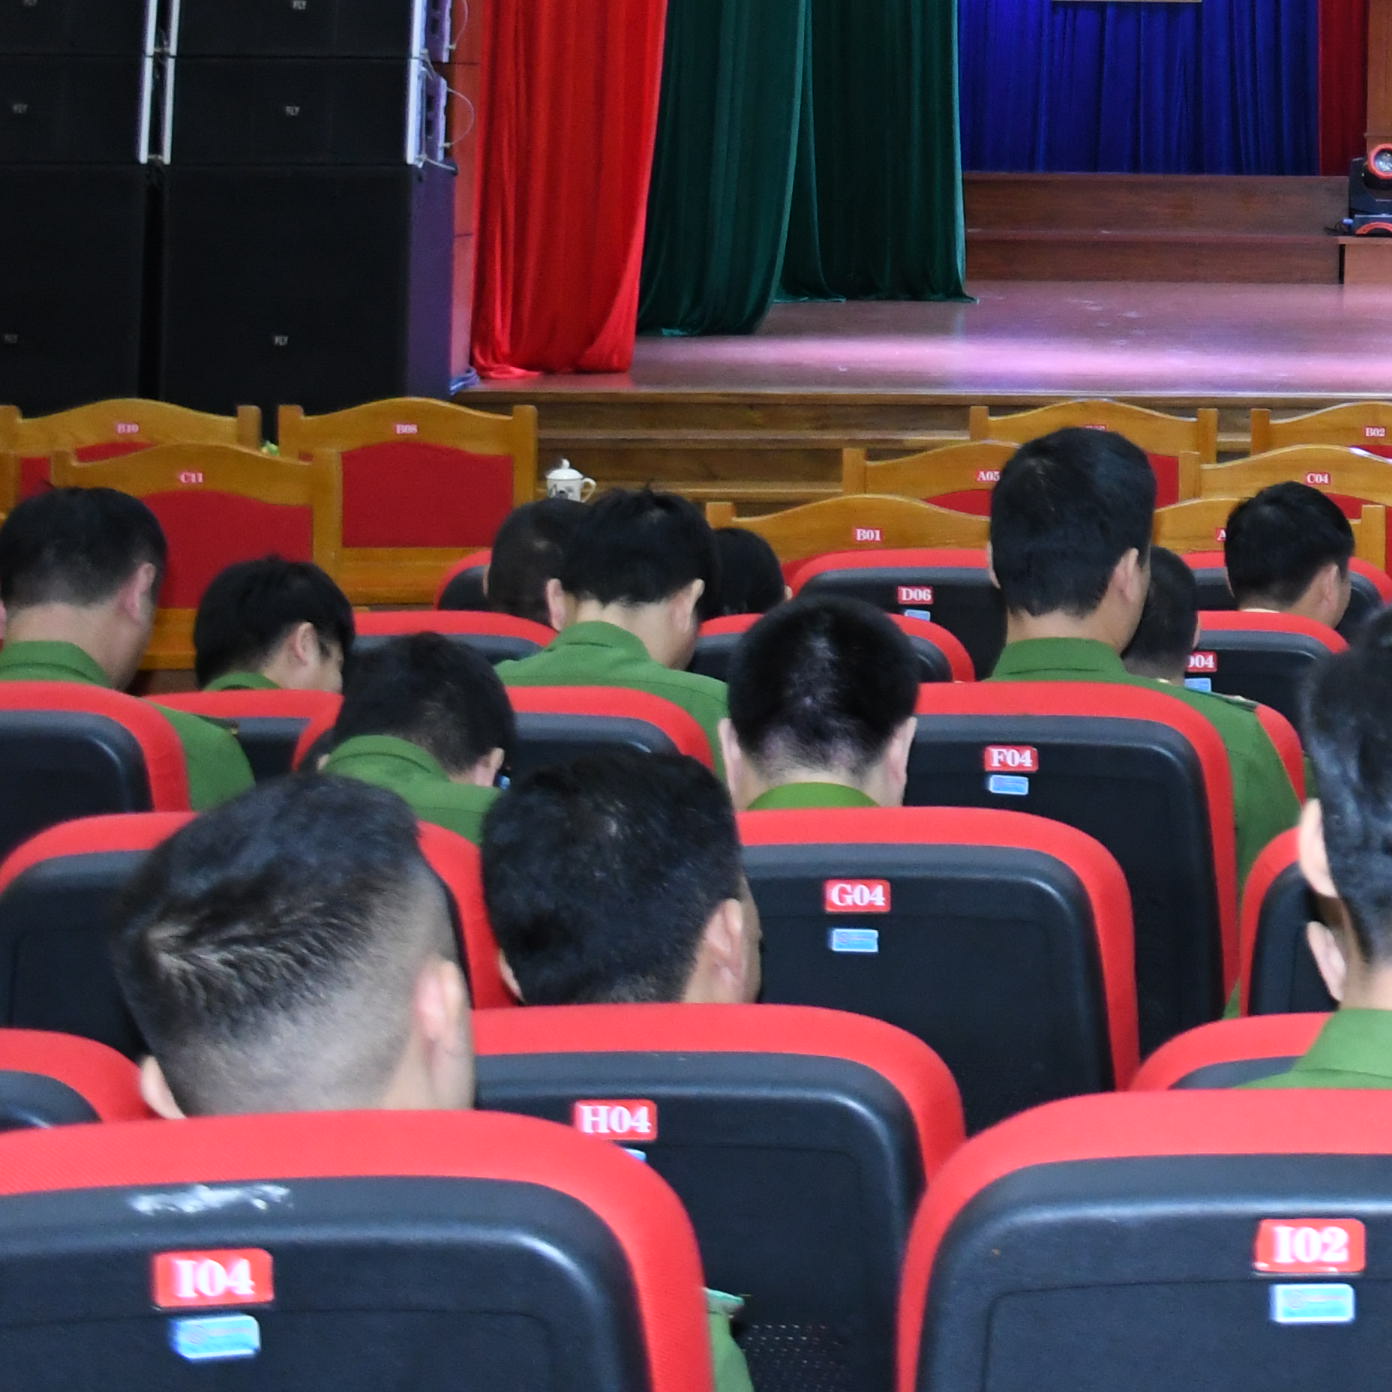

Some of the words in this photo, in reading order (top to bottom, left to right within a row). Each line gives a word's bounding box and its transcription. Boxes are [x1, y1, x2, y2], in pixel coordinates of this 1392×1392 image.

[1365, 427, 1386, 437] B02
[977, 470, 1000, 482] A05
[1306, 473, 1329, 484] C04
[855, 528, 881, 541] B01
[900, 587, 932, 602] D06
[989, 748, 1033, 767] F04
[830, 883, 886, 907] G04
[579, 1105, 651, 1134] H04
[1274, 1225, 1348, 1264] I02
[175, 1258, 255, 1299] I04
